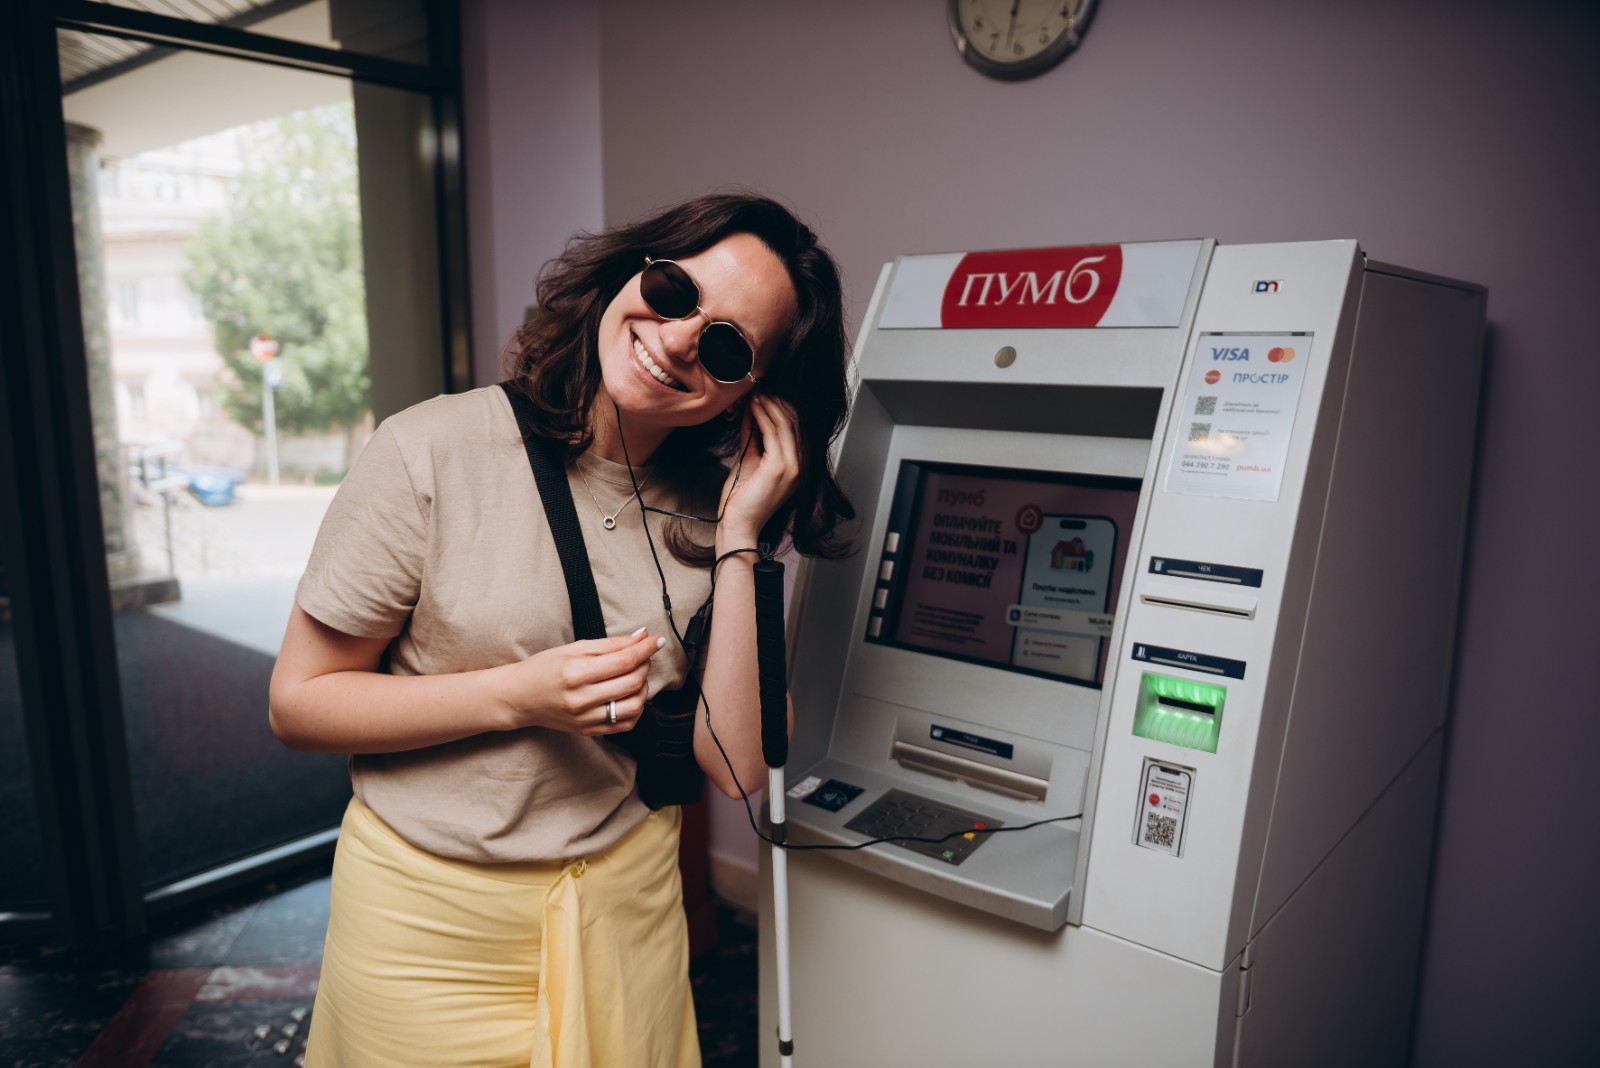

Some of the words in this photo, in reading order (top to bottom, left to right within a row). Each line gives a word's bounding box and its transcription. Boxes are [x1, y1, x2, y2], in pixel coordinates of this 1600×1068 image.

[990, 32, 1000, 52] 7
[1013, 41, 1025, 56] 6
[1210, 347, 1250, 361] VISA
[1232, 372, 1289, 384] ПРОСТІР
[1181, 460, 1194, 468] 044
[1195, 461, 1209, 469] 290
[1216, 462, 1230, 470] 290
[1236, 464, 1272, 473] pumb.ua
[933, 513, 1003, 534] ОПЛАЧУЙТЕ
[929, 531, 1001, 553] МОБІЛЬНИЙ
[1003, 540, 1017, 555] ТА
[926, 549, 1000, 570] КОМУНАЛКУ
[922, 565, 945, 581] БЕЗ
[946, 569, 993, 589] КОМІСІЇ
[1177, 652, 1198, 662] КАРТА
